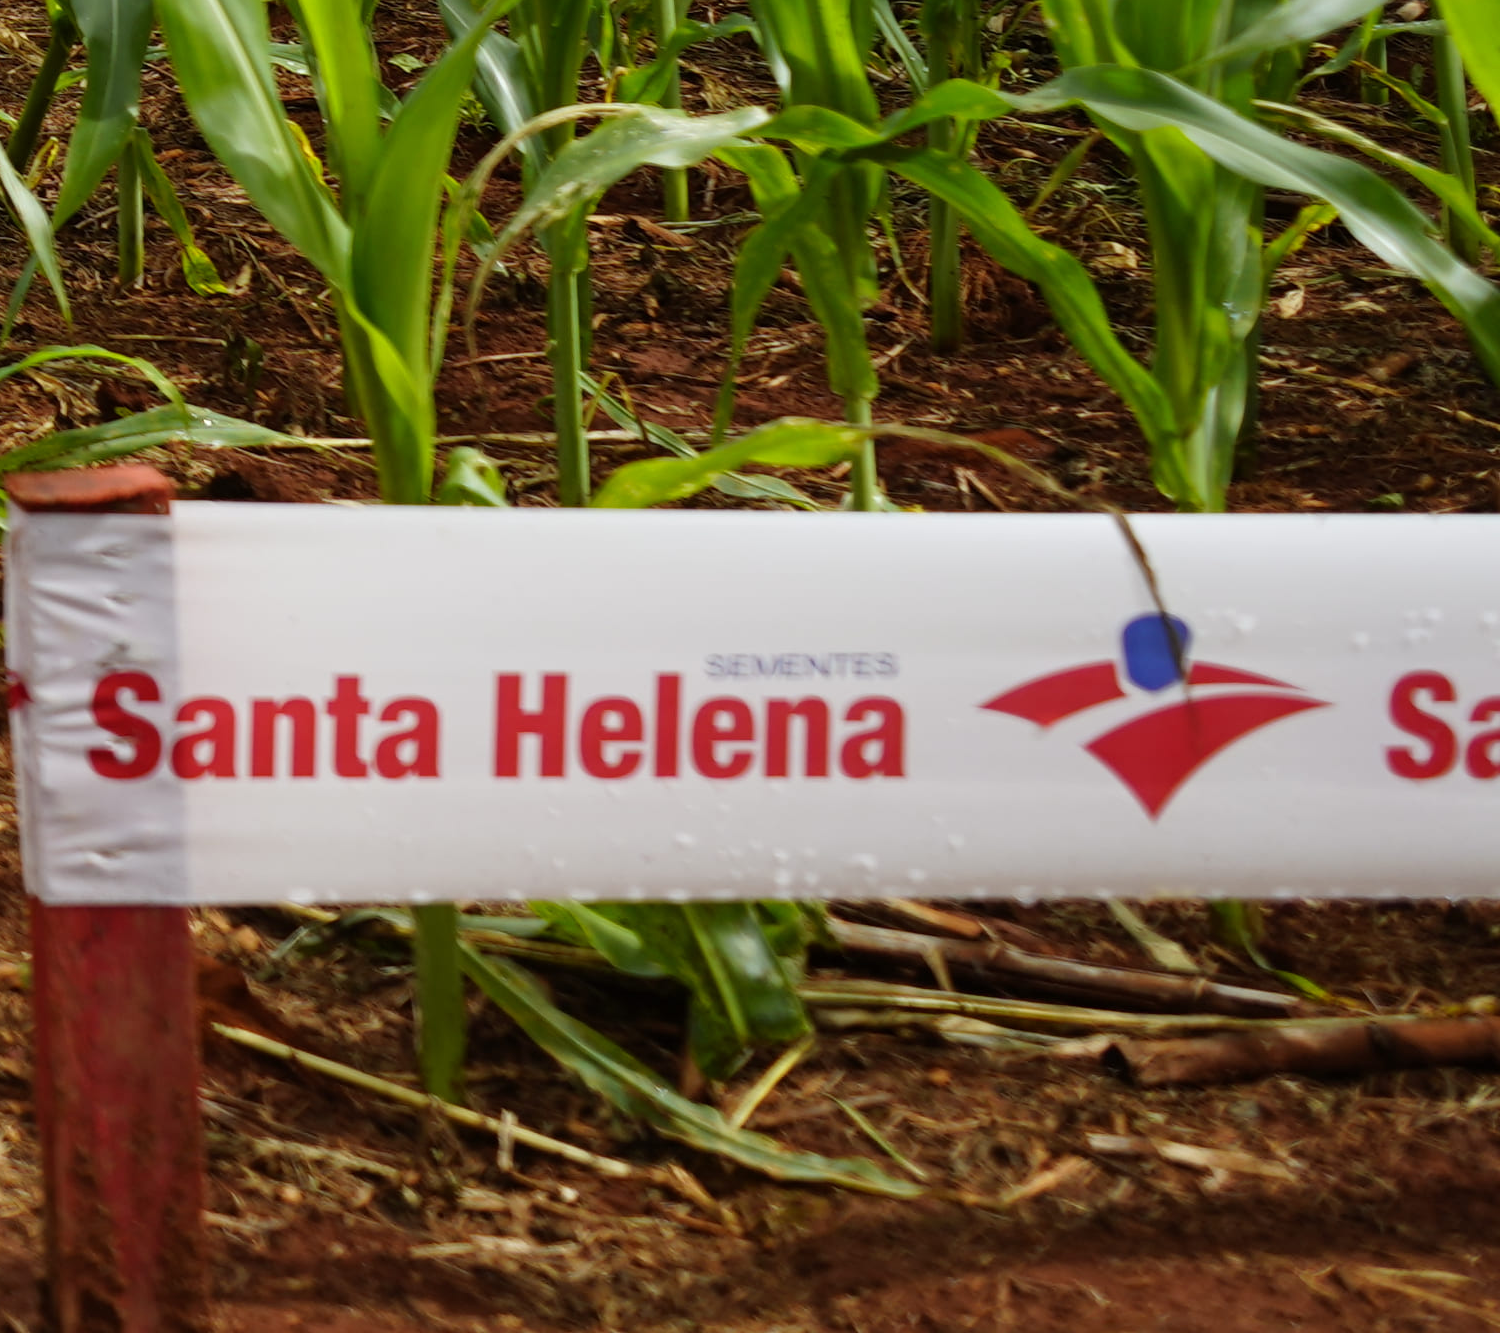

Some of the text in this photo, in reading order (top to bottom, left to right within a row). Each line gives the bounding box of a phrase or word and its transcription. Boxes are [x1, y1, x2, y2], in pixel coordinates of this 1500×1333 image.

[705, 652, 898, 679] SEMENTES
[85, 670, 906, 781] Santa Helena
